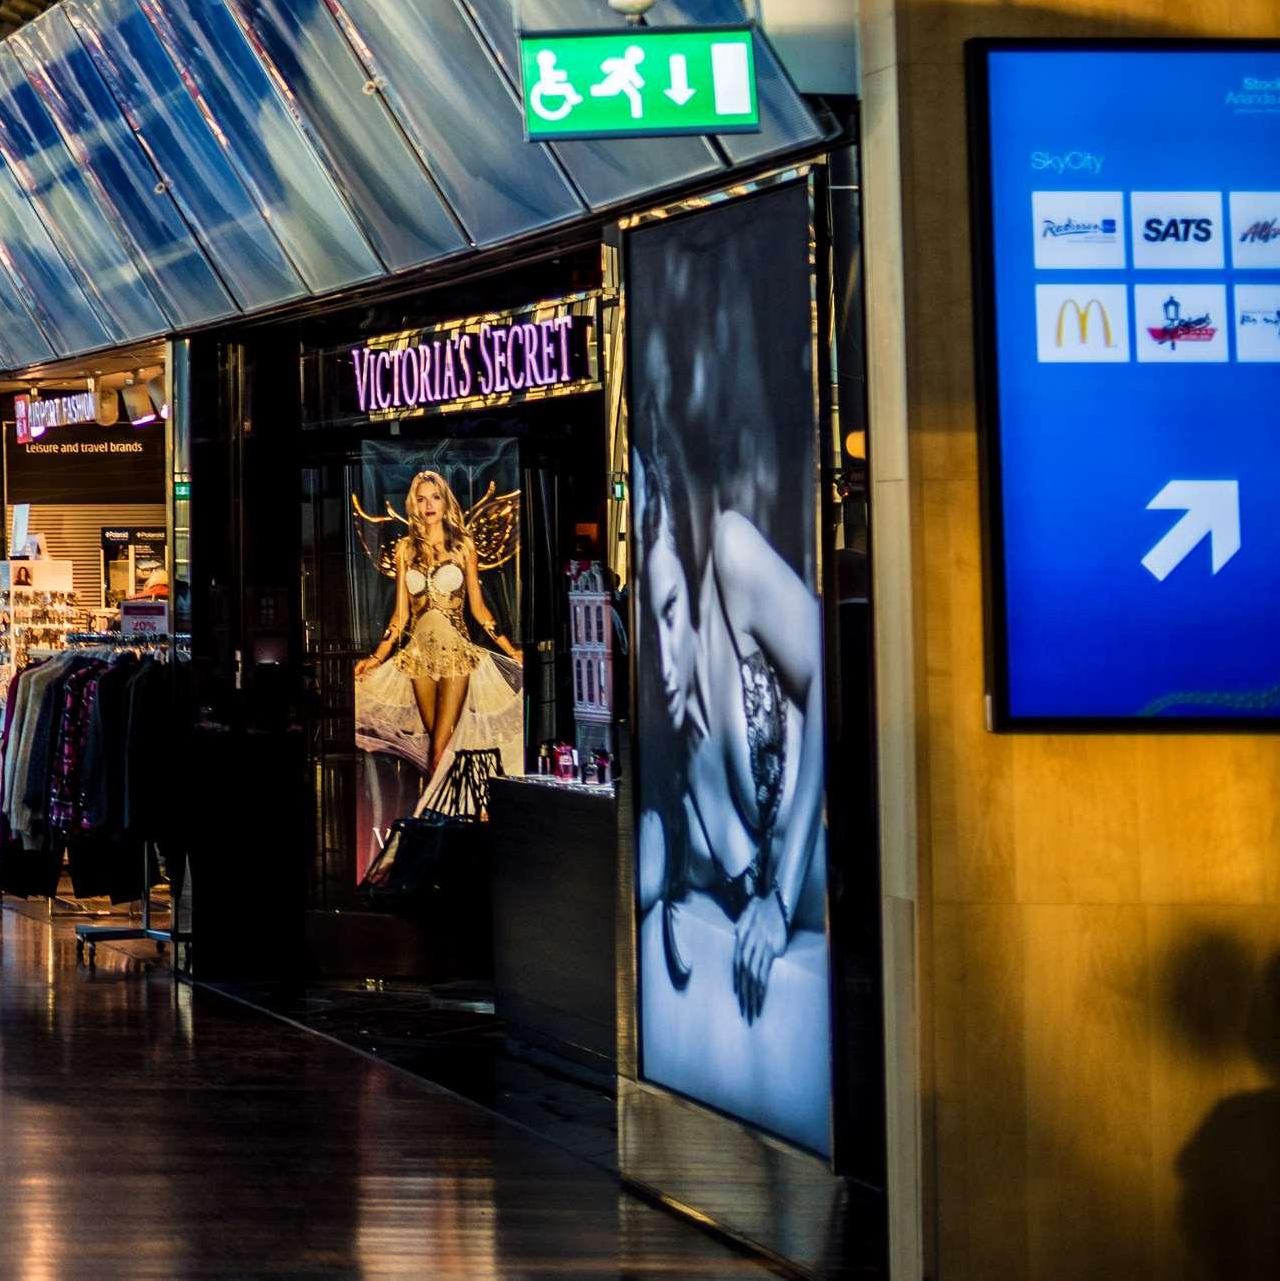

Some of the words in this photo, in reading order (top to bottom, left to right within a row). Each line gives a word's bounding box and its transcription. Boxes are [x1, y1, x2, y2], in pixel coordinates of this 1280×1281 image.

[1031, 151, 1104, 175] SkyCity
[1144, 218, 1213, 243] SATS
[351, 332, 472, 412] VICTORIA'S
[479, 316, 573, 395] SECRET
[28, 398, 60, 427] AIRPORT
[26, 443, 59, 453] Leisure
[60, 443, 79, 453] and
[80, 442, 108, 453] travel
[110, 442, 143, 453] brands
